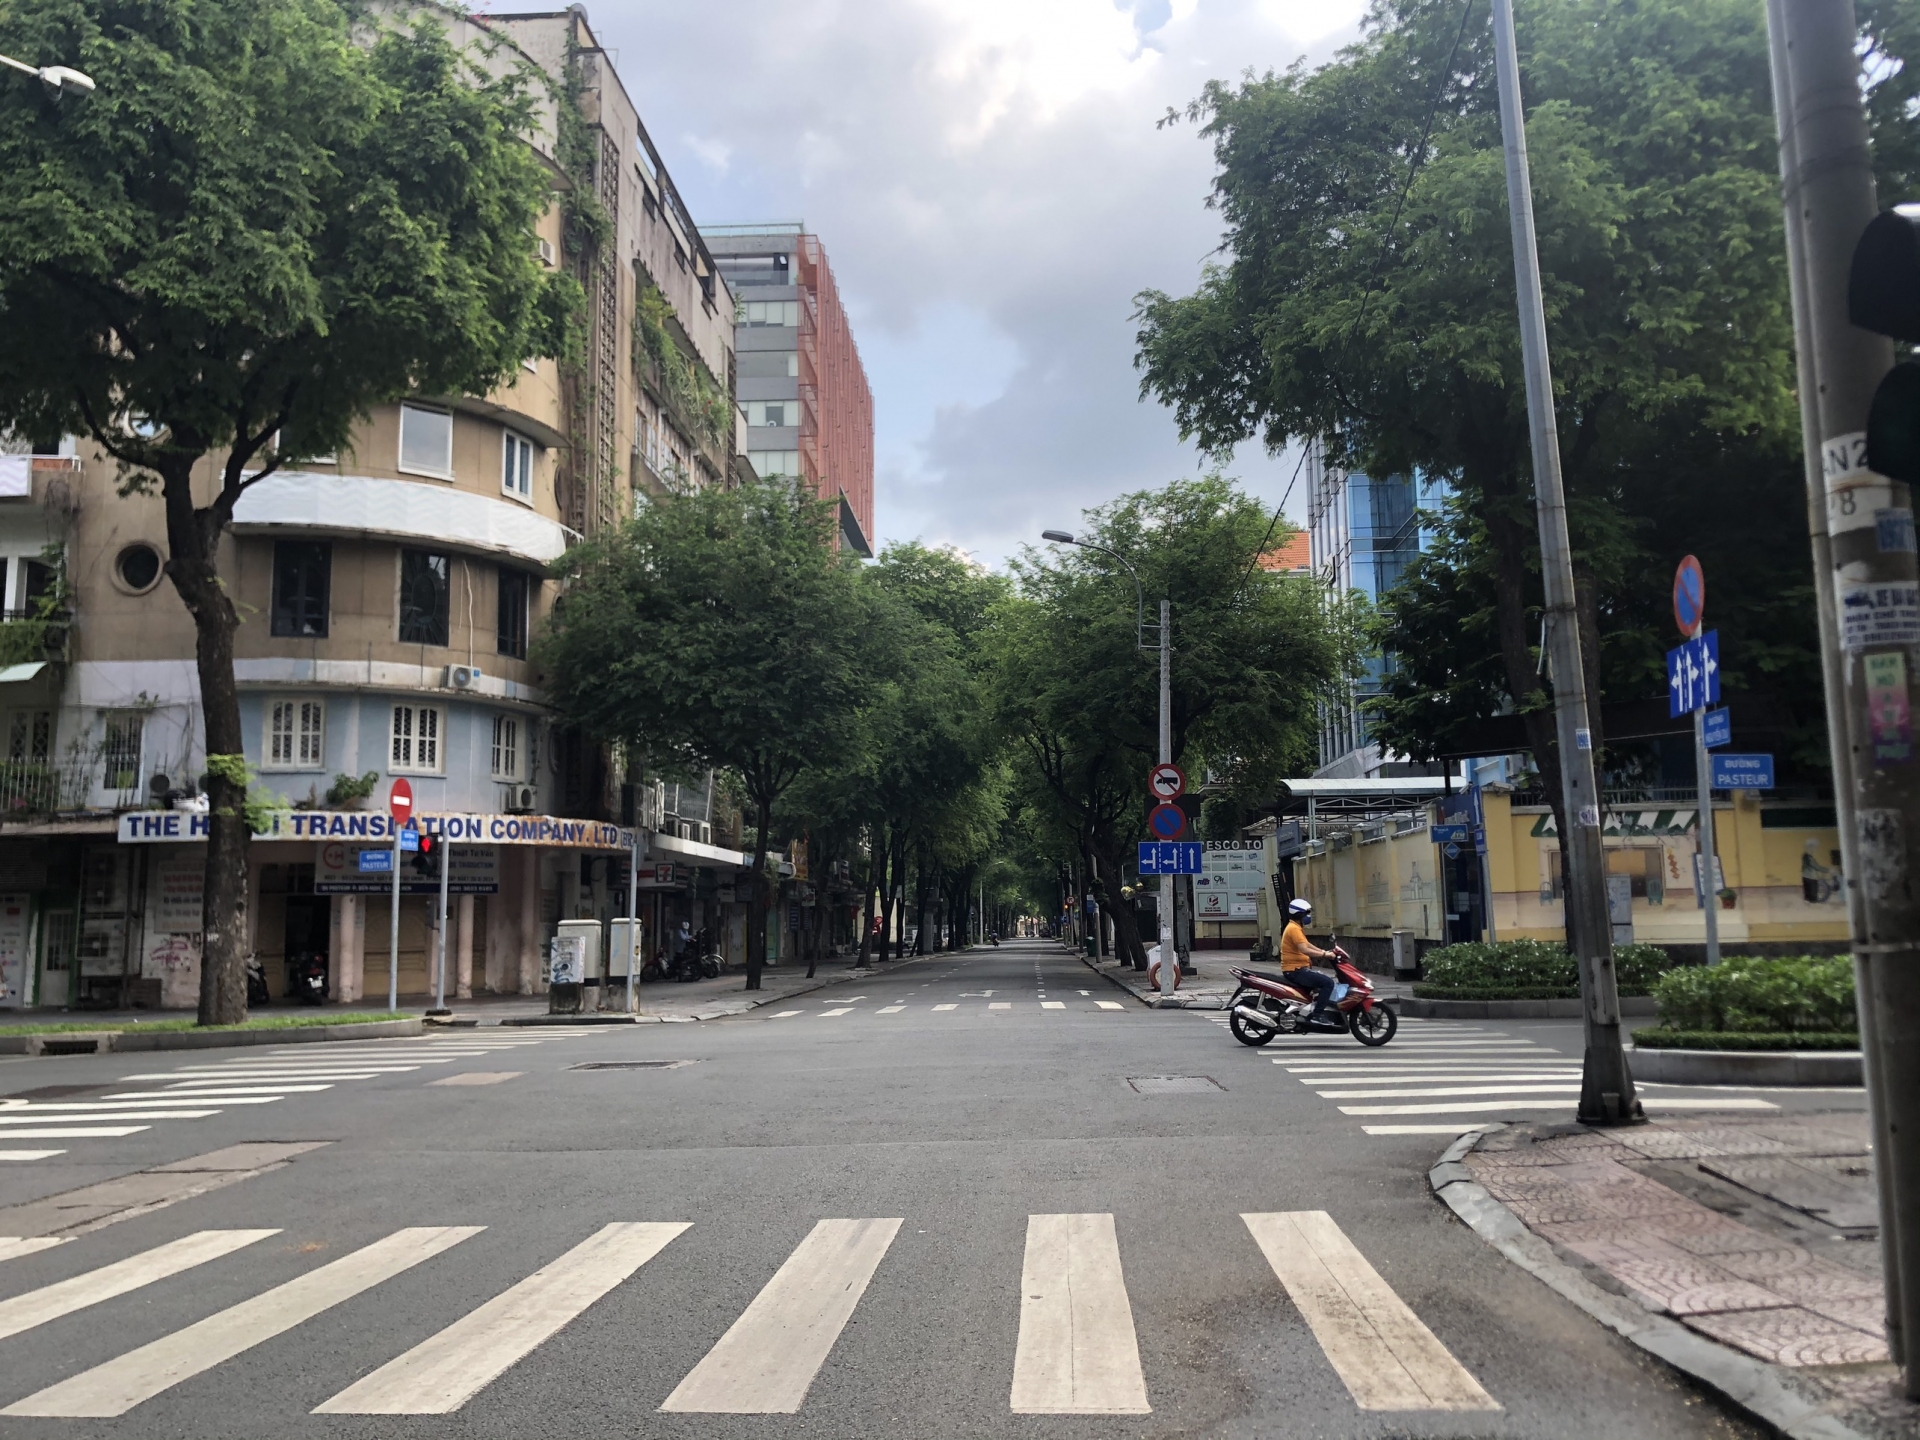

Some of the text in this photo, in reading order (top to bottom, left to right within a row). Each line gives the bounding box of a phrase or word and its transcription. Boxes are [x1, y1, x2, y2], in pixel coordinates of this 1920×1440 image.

[1717, 773, 1769, 785] PASTEUR
[127, 815, 180, 836] THE
[593, 825, 618, 845] LTD
[1202, 840, 1240, 850] ESCO
